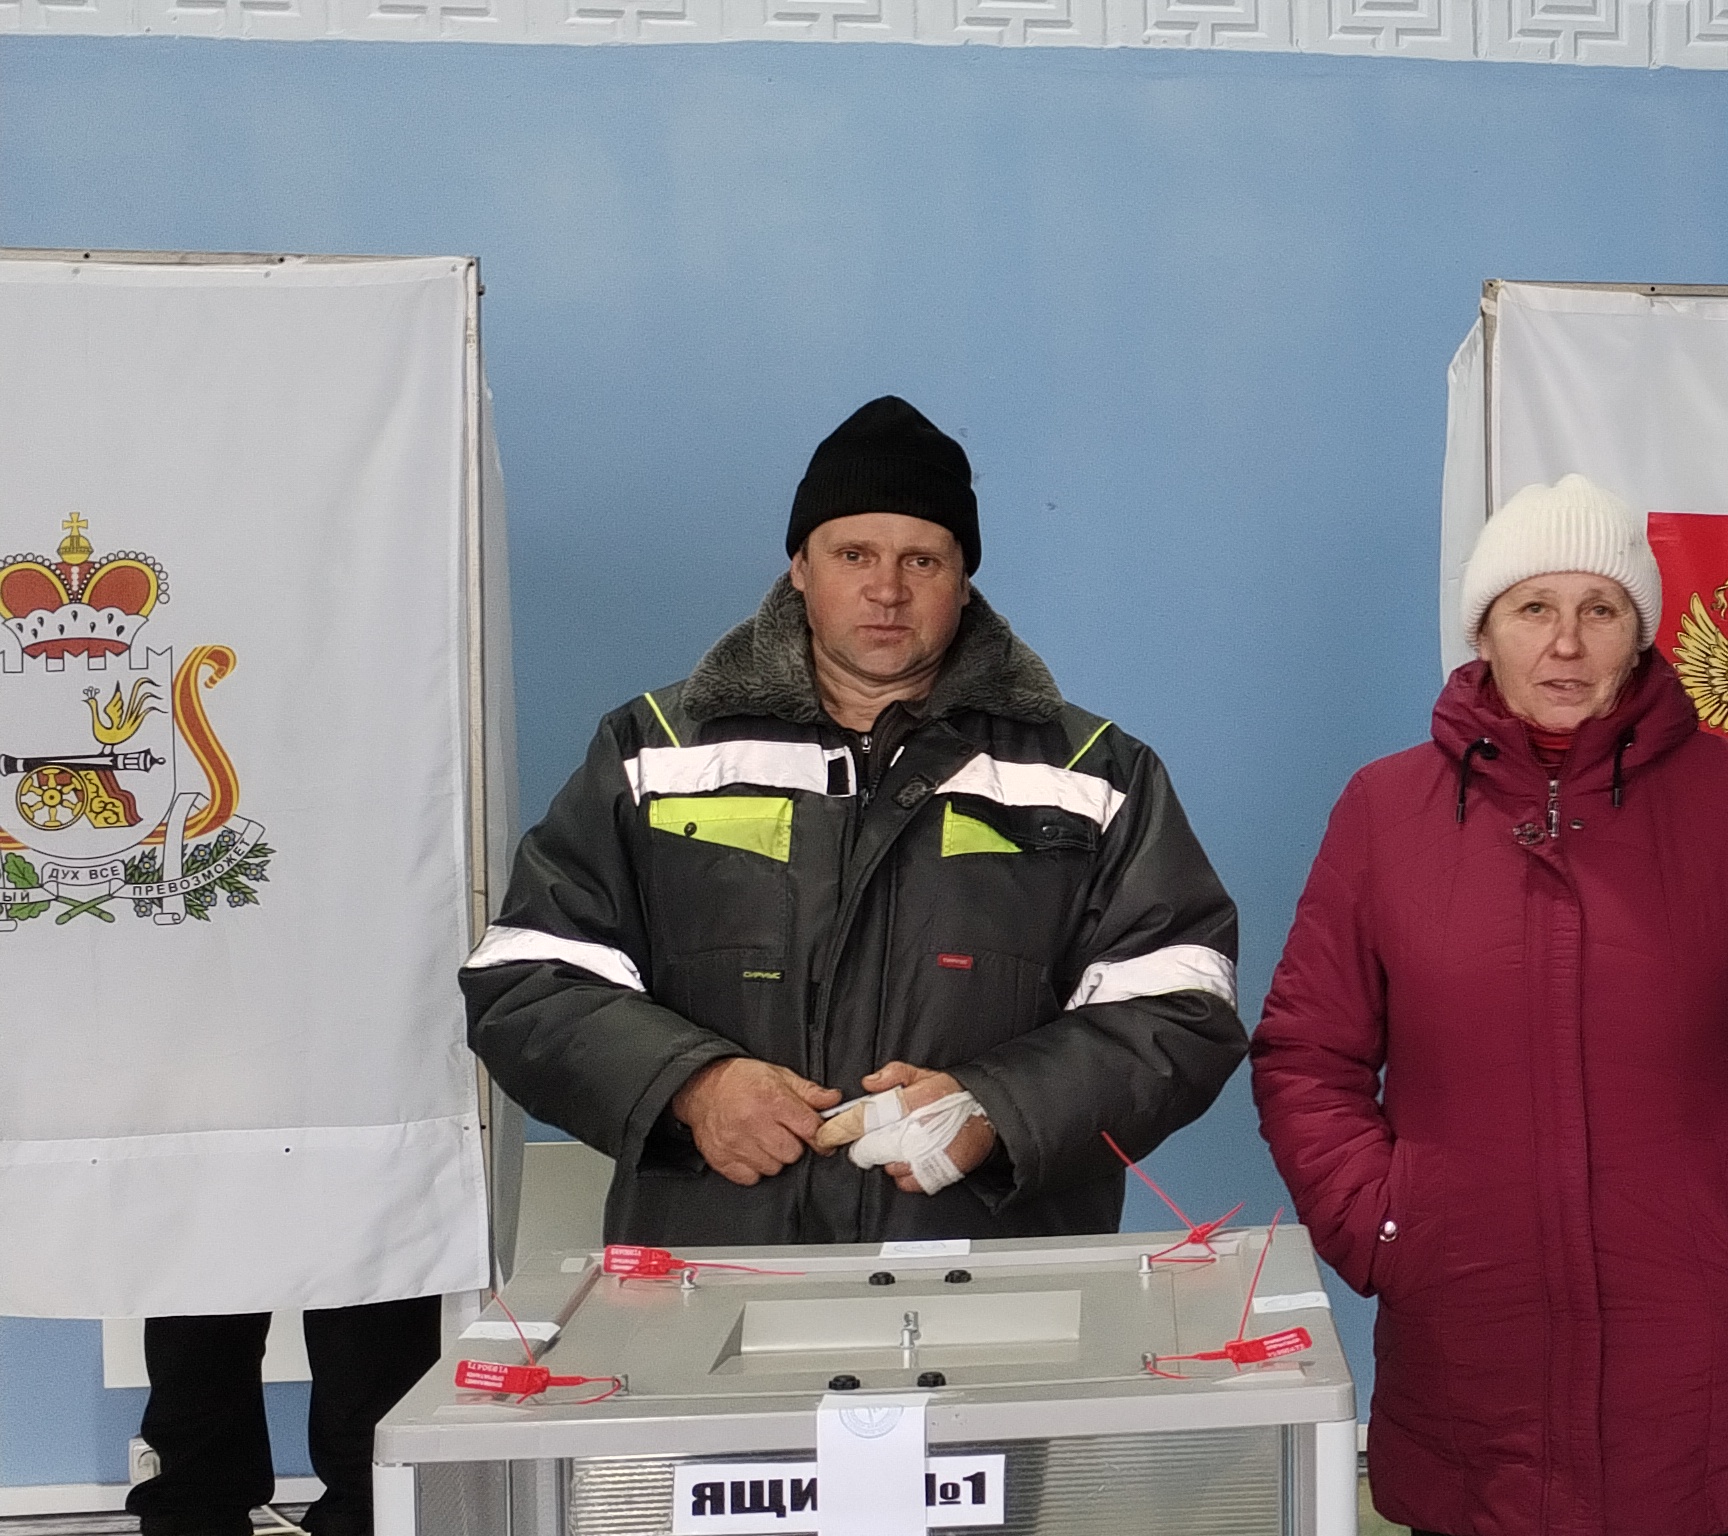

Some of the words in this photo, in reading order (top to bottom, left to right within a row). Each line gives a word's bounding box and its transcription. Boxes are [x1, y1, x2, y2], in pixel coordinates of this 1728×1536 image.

[47, 867, 80, 881] ДУХ
[89, 865, 121, 879] ВСЕ
[132, 837, 251, 897] ПРЕВОЗМОЖЕТ
[691, 1477, 818, 1518] ЯЩИ
